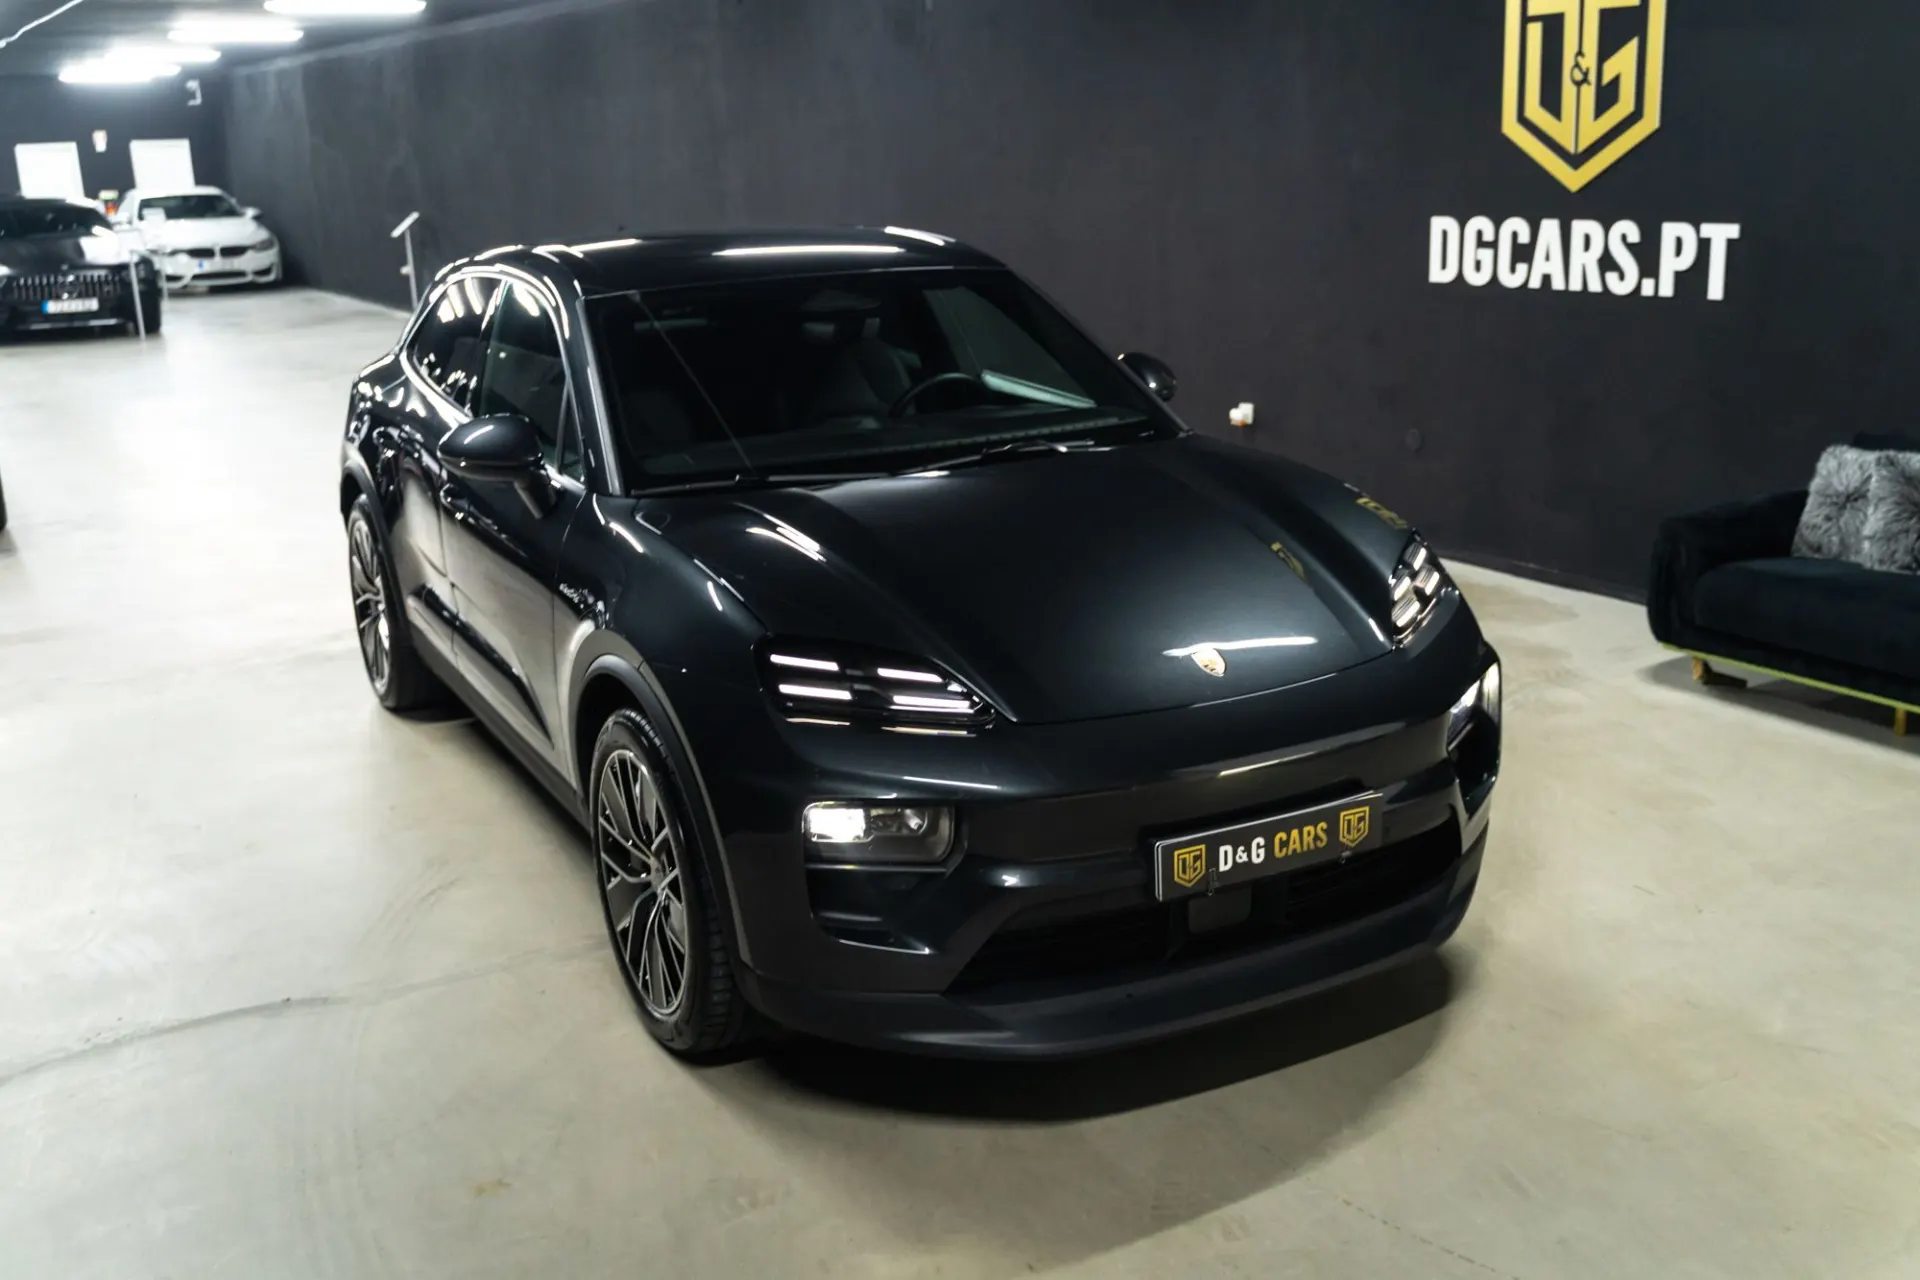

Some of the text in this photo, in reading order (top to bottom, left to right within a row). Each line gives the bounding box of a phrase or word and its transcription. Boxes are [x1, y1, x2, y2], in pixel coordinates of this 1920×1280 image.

[1428, 215, 1741, 301] DGCARS.PT
[1219, 821, 1328, 872] D&G CARS
